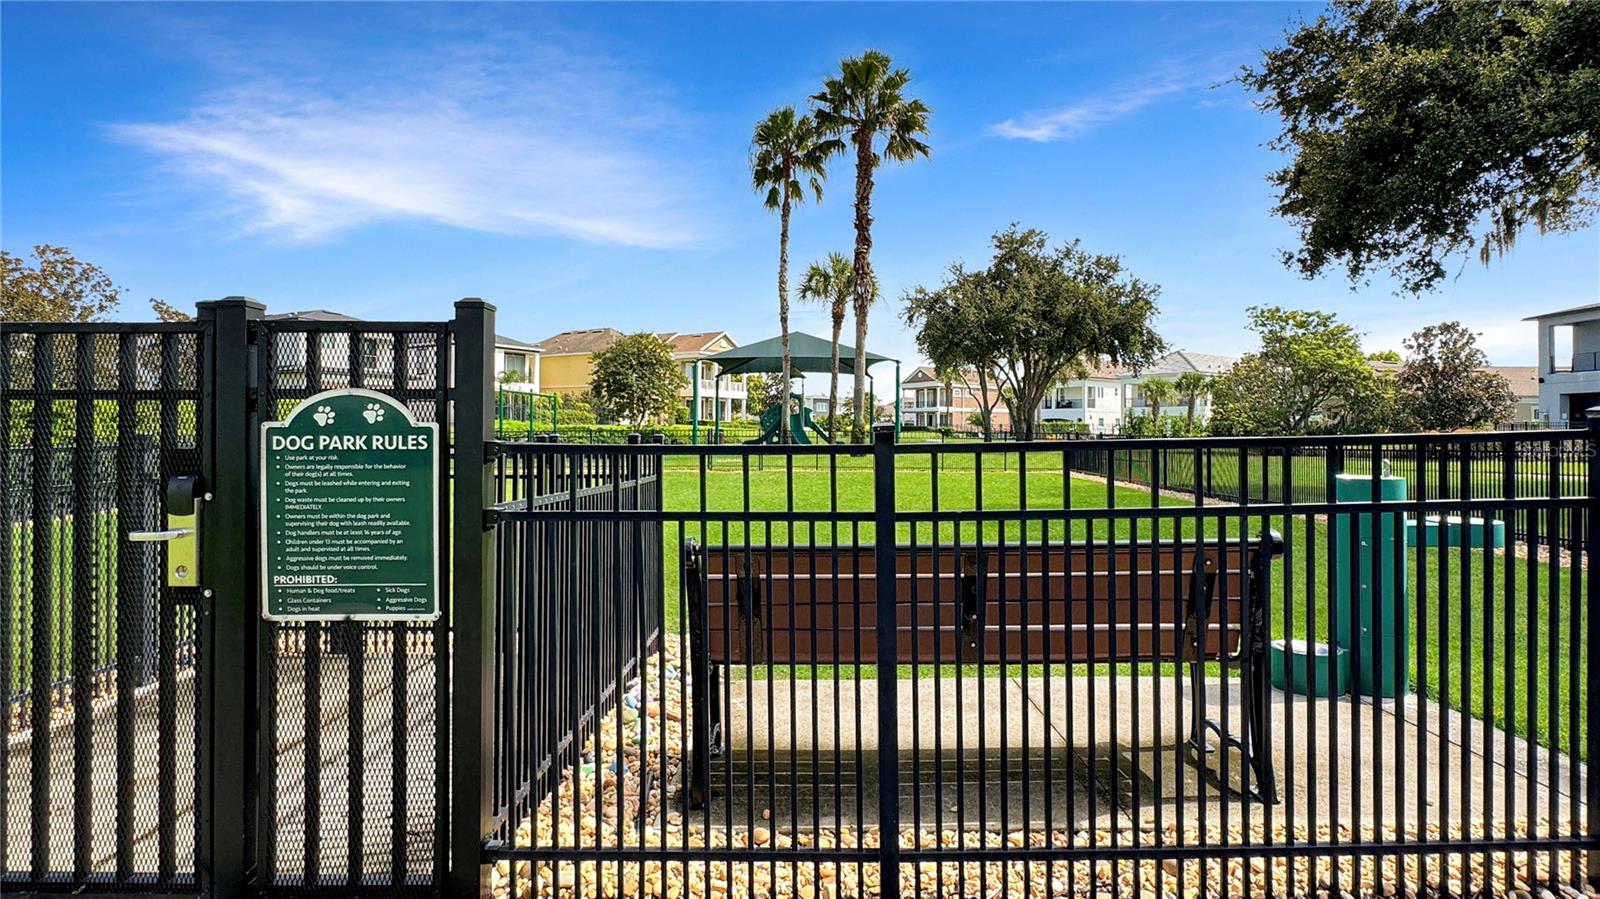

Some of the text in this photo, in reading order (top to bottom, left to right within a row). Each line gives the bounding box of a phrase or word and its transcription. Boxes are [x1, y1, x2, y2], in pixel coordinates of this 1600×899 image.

[272, 435, 428, 450] DOG PARK RULES
[274, 575, 337, 583] PROHIBITED:
[313, 587, 324, 595] Dog
